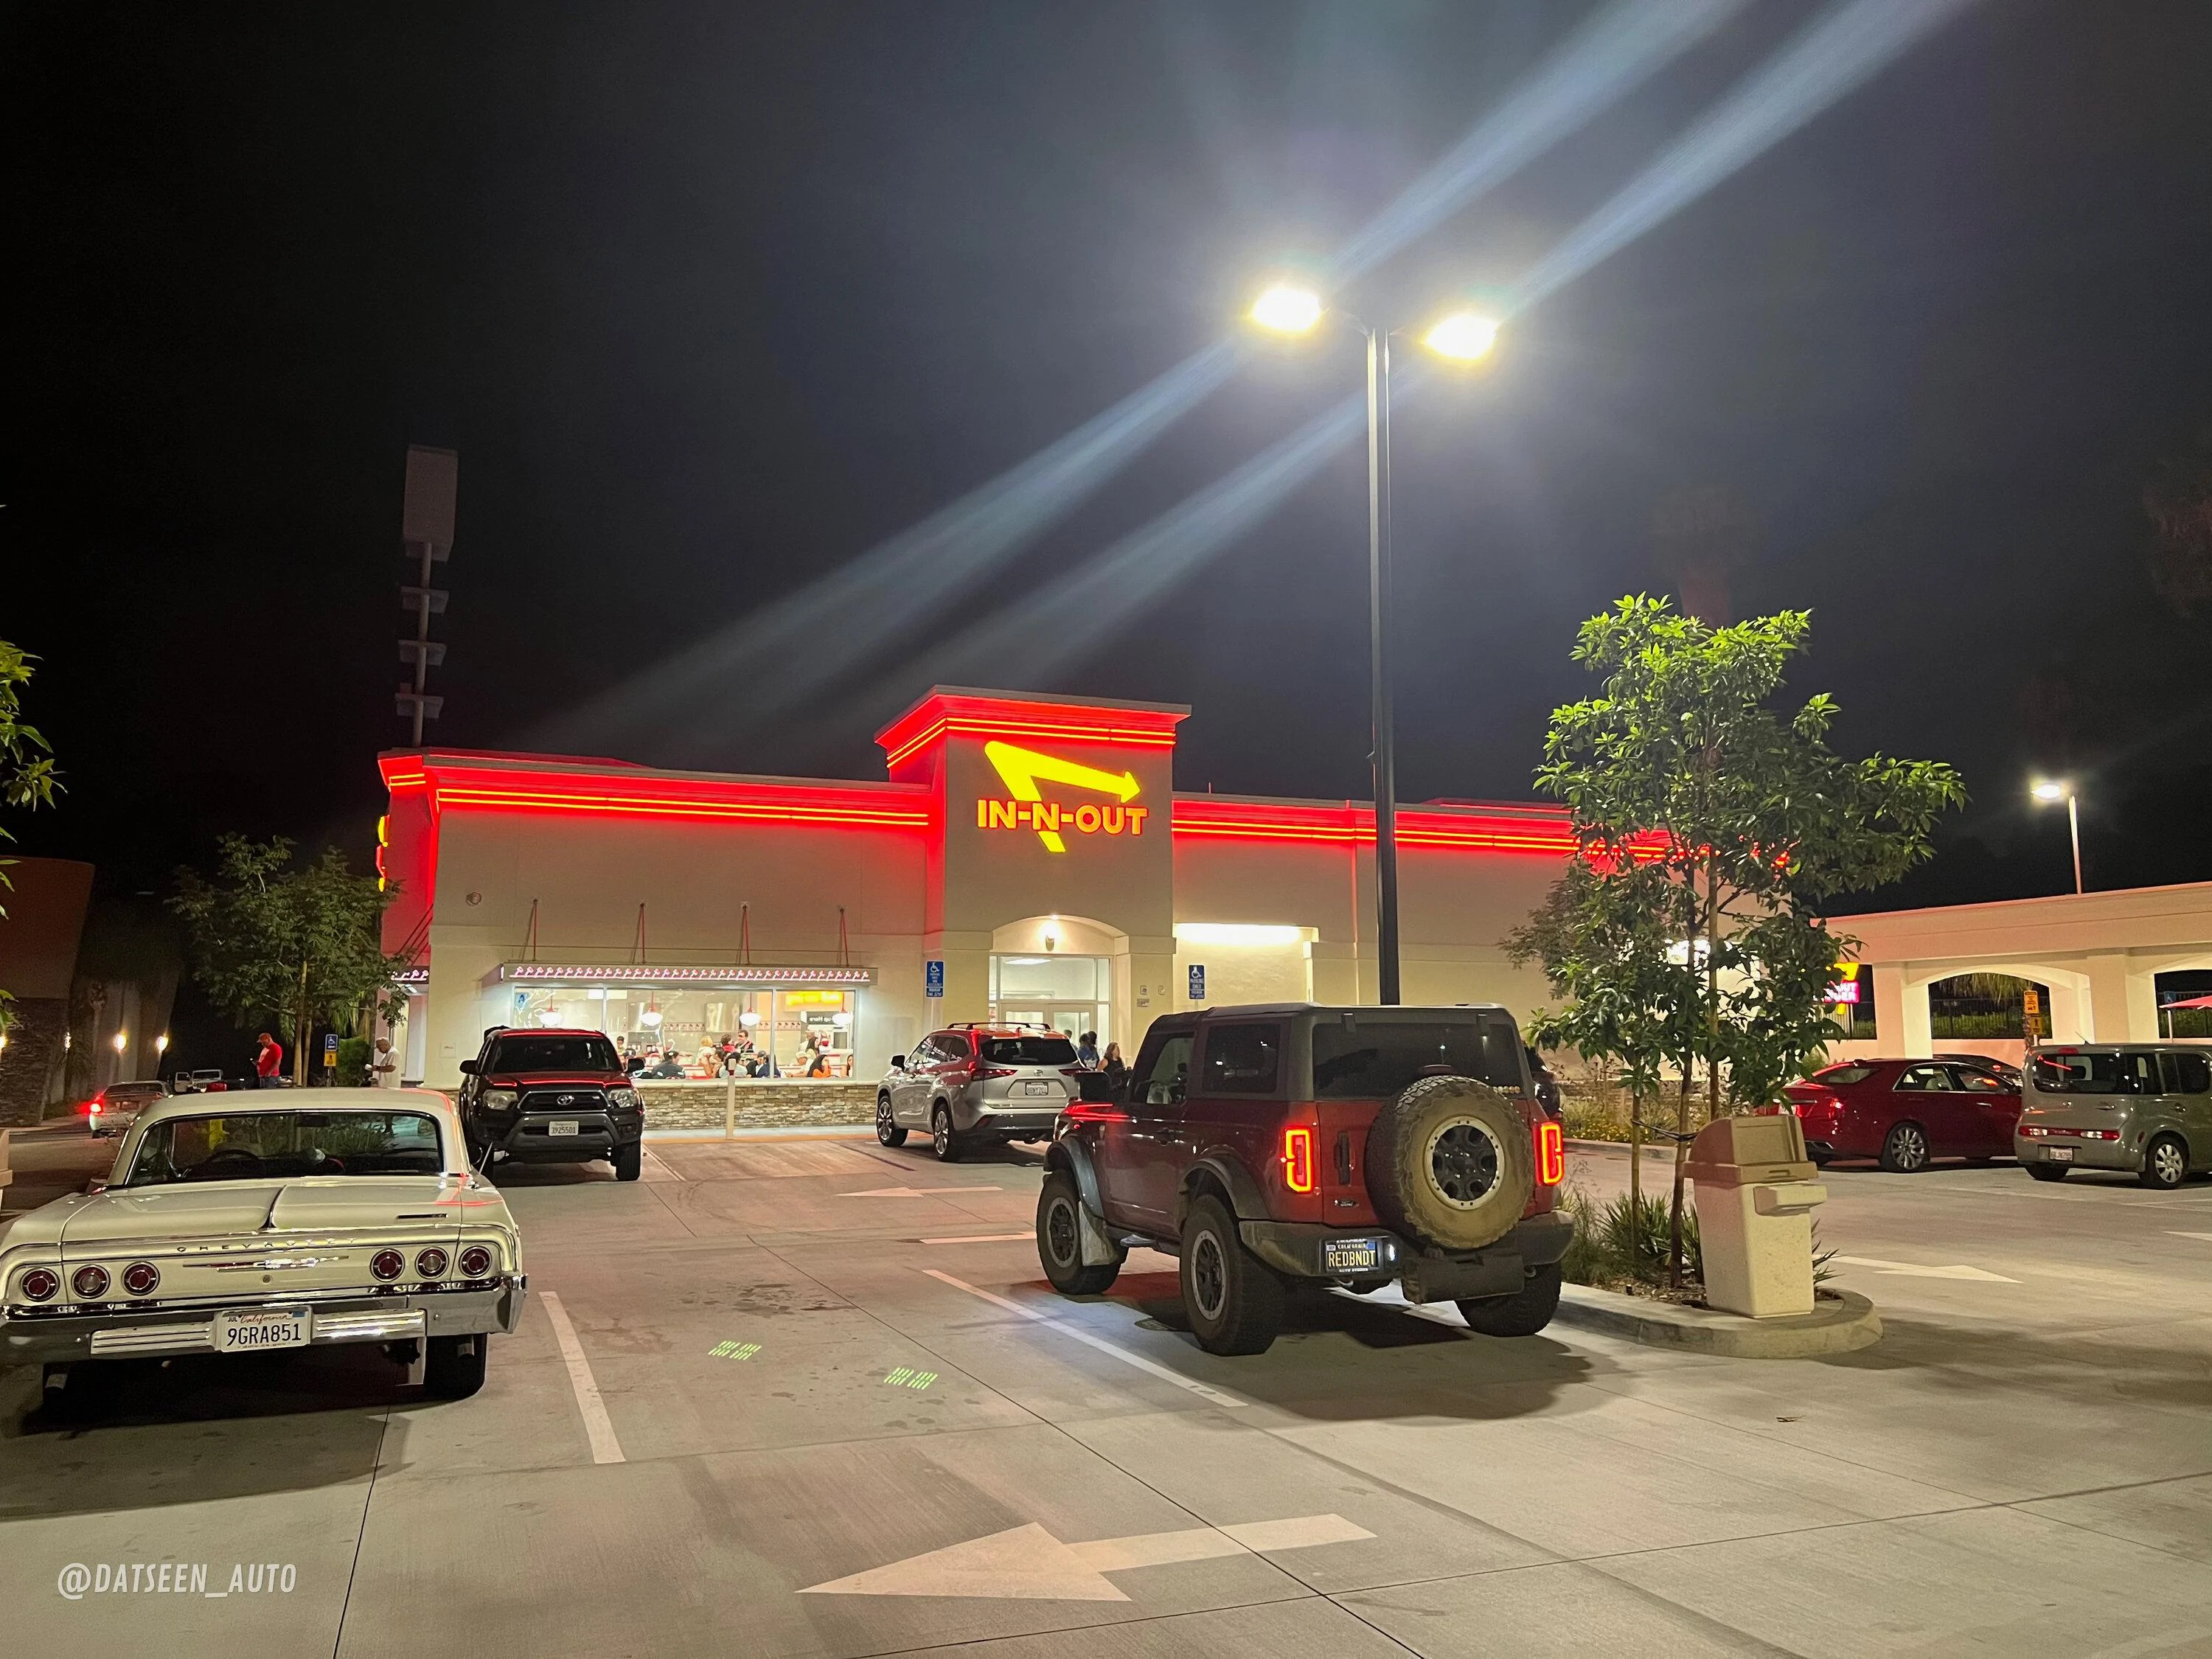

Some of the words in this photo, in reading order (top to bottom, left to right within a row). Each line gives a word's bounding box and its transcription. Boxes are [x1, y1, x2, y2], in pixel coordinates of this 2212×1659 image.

[977, 799, 1147, 835] IN-N-OUT
[1328, 1251, 1375, 1267] REDBNDT
[240, 1313, 293, 1325] California
[227, 1324, 301, 1346] 9GRA851
